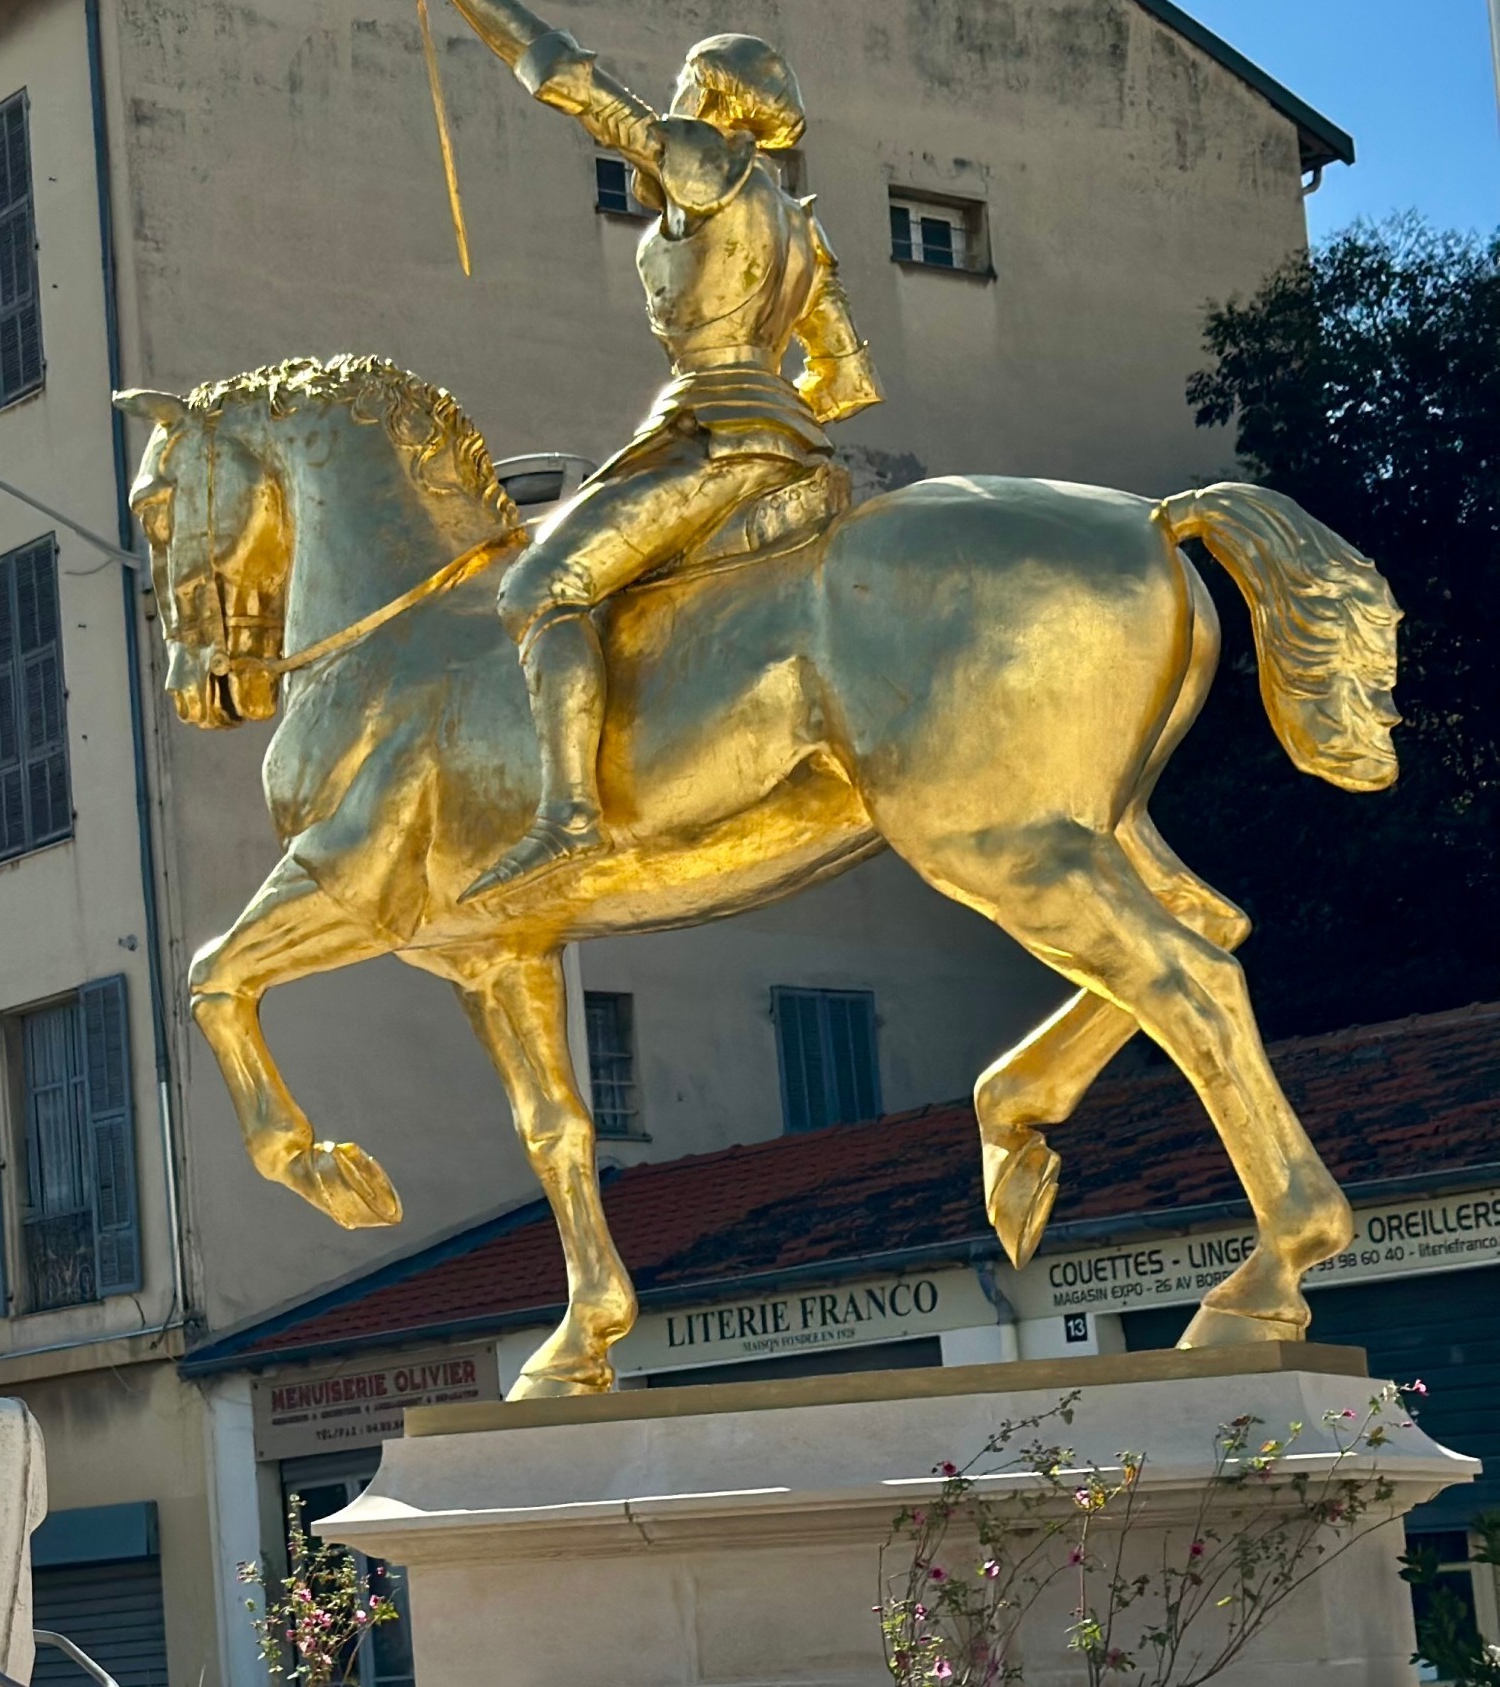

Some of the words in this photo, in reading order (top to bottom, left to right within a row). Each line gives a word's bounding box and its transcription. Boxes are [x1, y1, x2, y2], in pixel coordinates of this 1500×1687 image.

[1050, 1250, 1164, 1288] COUETTES
[1054, 1287, 1108, 1306] MAGASIN
[1111, 1282, 1143, 1299] EXPO
[1155, 1278, 1173, 1294] 26
[1176, 1275, 1192, 1291] AV
[1338, 1252, 1358, 1269] 98
[1361, 1249, 1380, 1266] 60
[1384, 1245, 1405, 1262] 40
[667, 1301, 791, 1348] LITERIE
[800, 1279, 938, 1329] FRANCO
[1067, 1318, 1086, 1337] 13
[271, 1373, 388, 1413] MENUISERIE
[393, 1359, 477, 1393] OLIVIER
